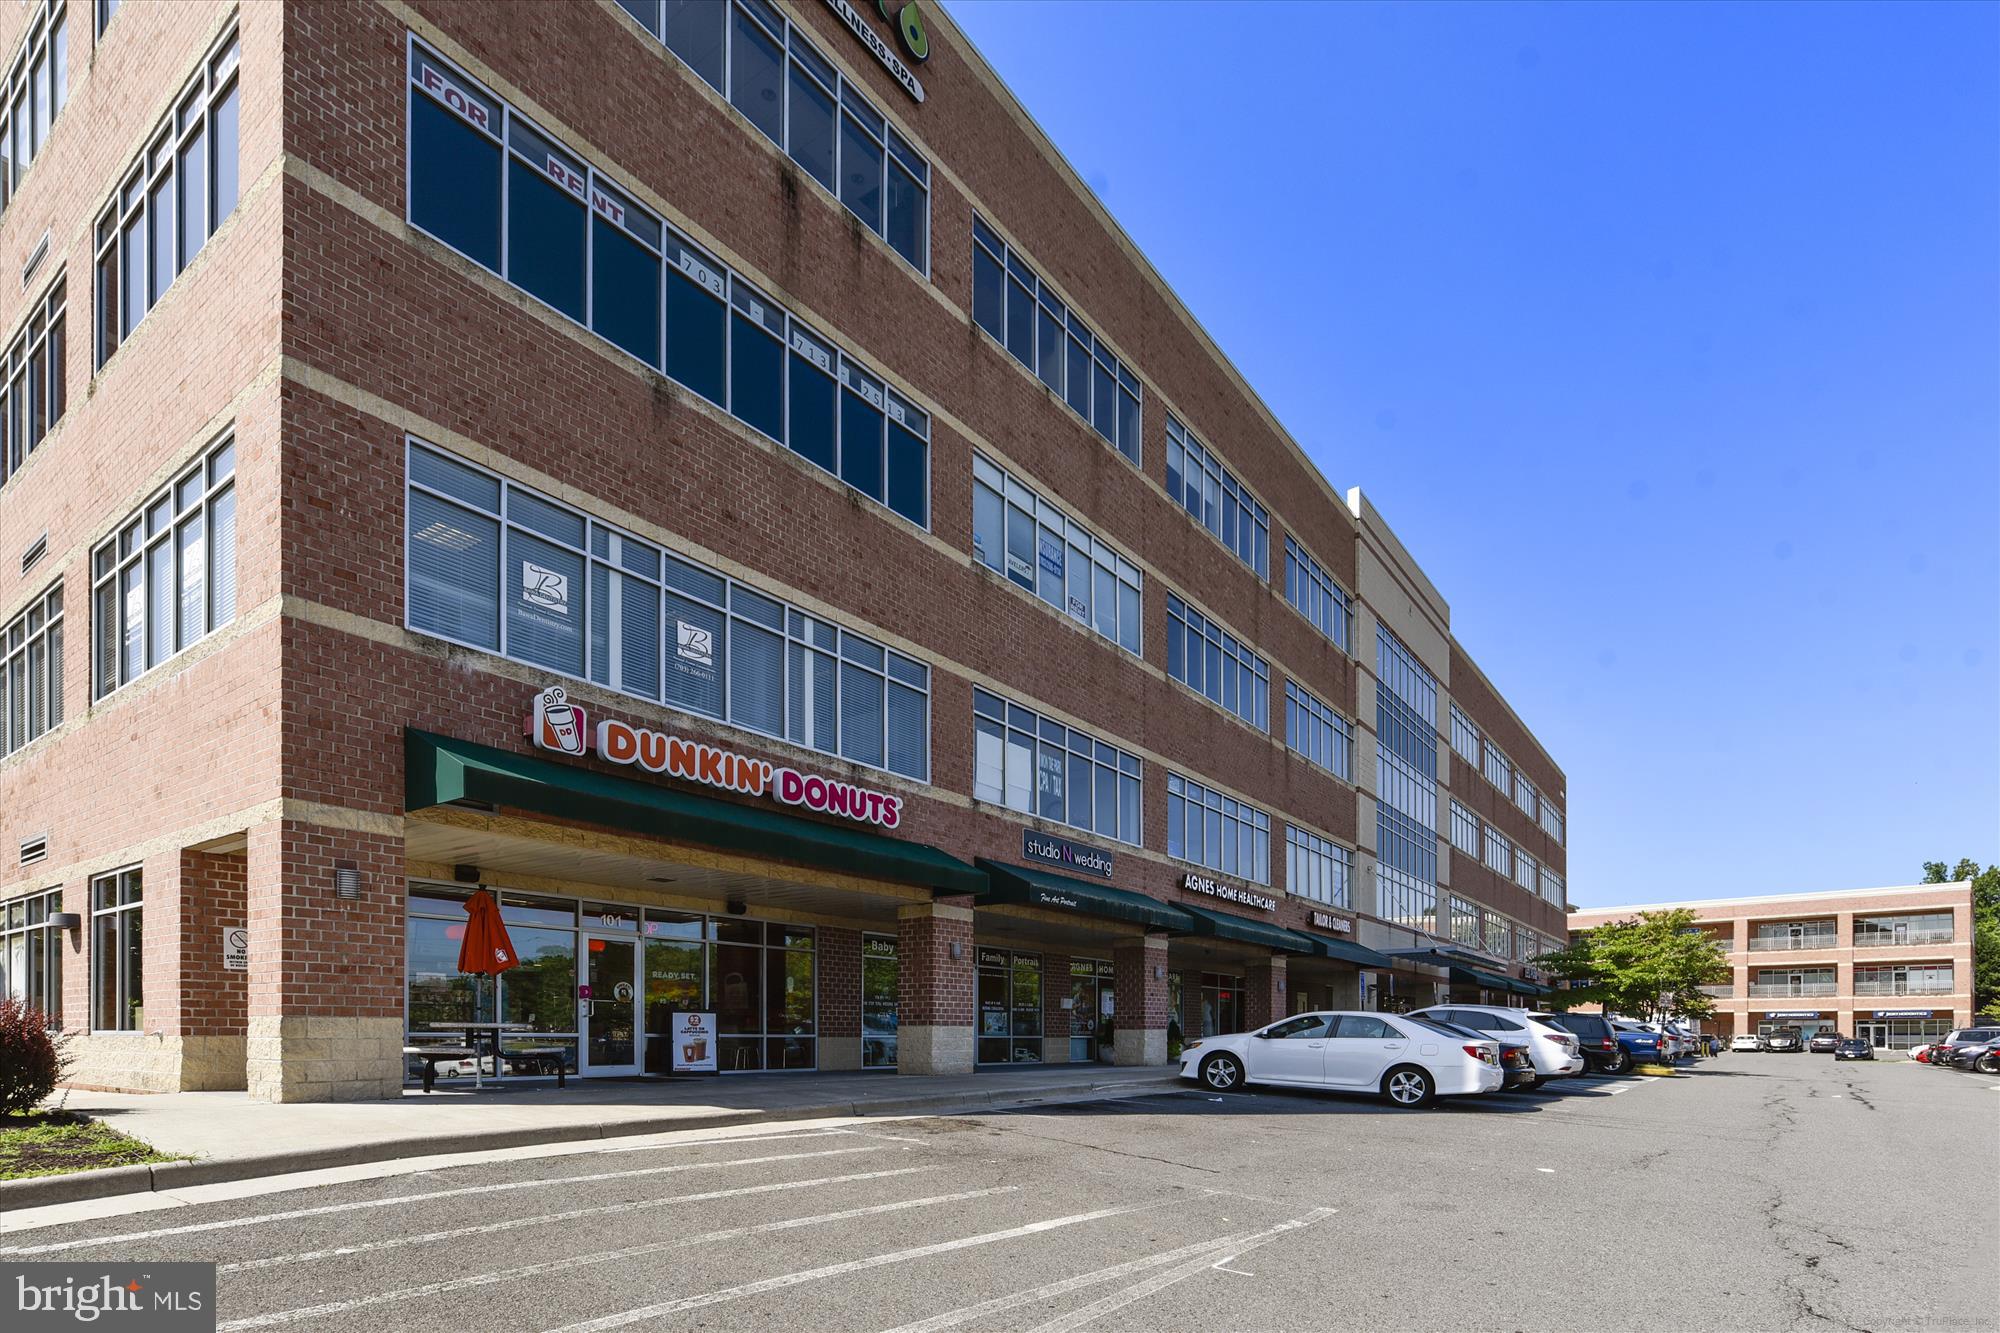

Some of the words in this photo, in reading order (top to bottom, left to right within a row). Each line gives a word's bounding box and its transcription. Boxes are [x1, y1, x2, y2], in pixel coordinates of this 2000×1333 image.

[830, 0, 886, 60] LLNESS
[893, 60, 916, 94] SPA
[424, 68, 488, 130] FOR
[549, 159, 624, 223] RENT
[606, 722, 771, 797] DUNKIN'
[782, 769, 897, 827] DONUTS
[1027, 839, 1060, 860] studio
[1062, 844, 1073, 864] N
[1074, 852, 1112, 877] wedding
[1184, 873, 1215, 896] AGNES
[1216, 884, 1238, 902] HOME
[1238, 890, 1276, 912] HEALTHCARE
[600, 914, 622, 927] 101
[1314, 911, 1328, 927] TAILOR
[1333, 917, 1351, 934] CLEANERS
[871, 940, 894, 955] Baby
[981, 951, 1005, 966] Family
[1071, 962, 1093, 972] AGNES
[1098, 965, 1114, 974] HOM
